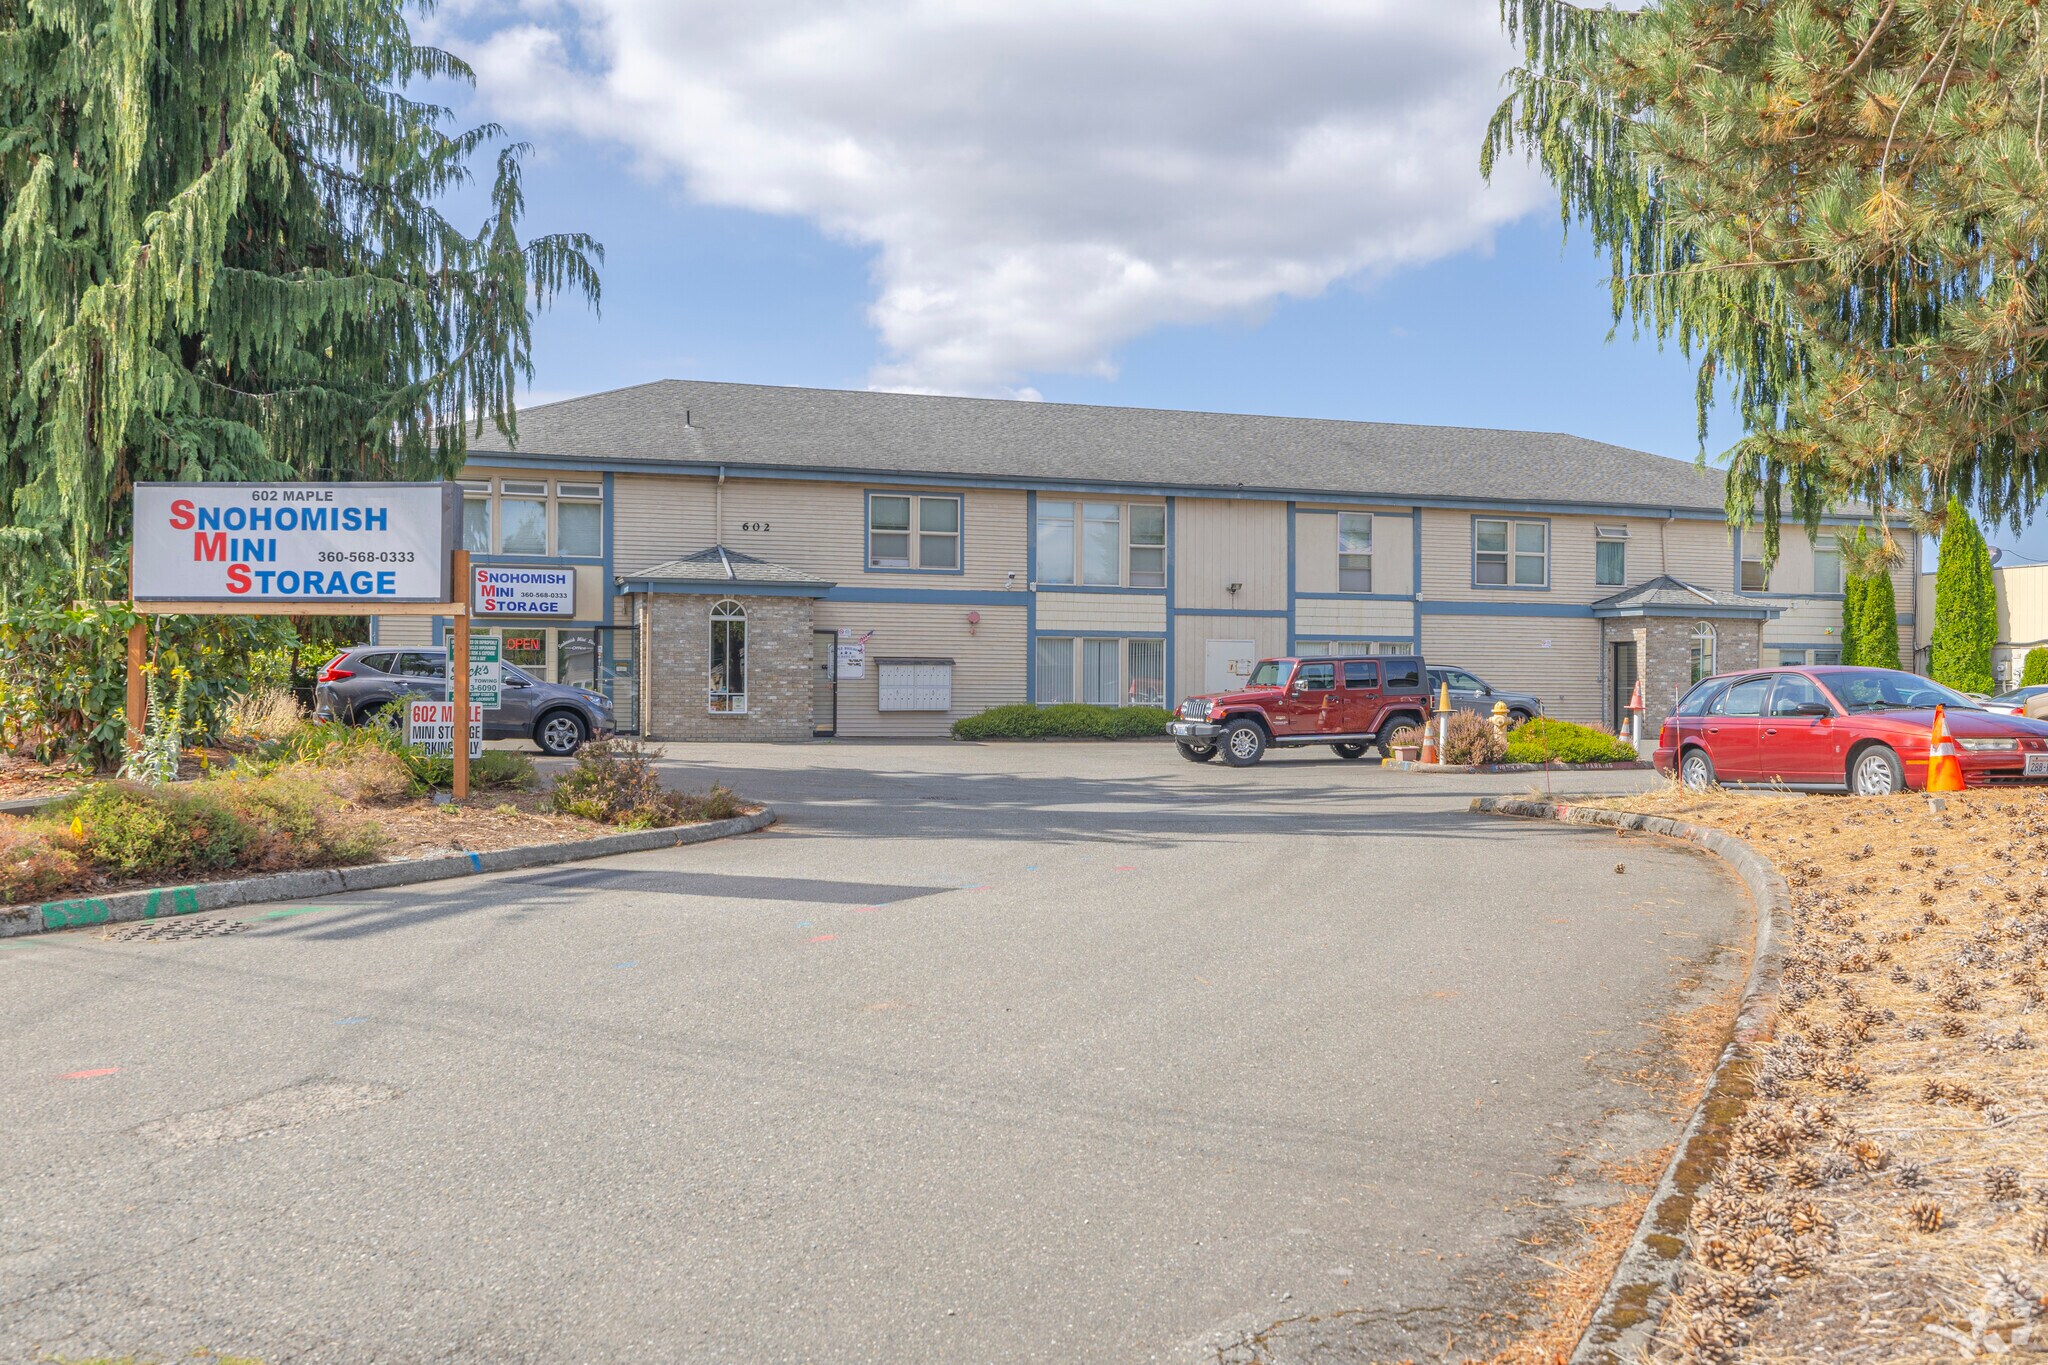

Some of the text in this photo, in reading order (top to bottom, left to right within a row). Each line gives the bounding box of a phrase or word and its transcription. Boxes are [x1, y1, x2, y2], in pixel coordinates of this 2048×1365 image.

[252, 491, 333, 501] 602 MAPLE
[169, 499, 388, 531] SNOHOMISH
[742, 522, 770, 531] 602
[193, 532, 415, 562] MINI 360-568-0333
[225, 563, 396, 594] STORAGE
[477, 570, 566, 584] SNOHOMISH
[481, 585, 514, 597] MINI
[485, 599, 558, 612] STORAGE
[507, 638, 540, 650] OPEN
[413, 706, 481, 722] 602 MLE
[413, 726, 480, 739] MINI STOGE
